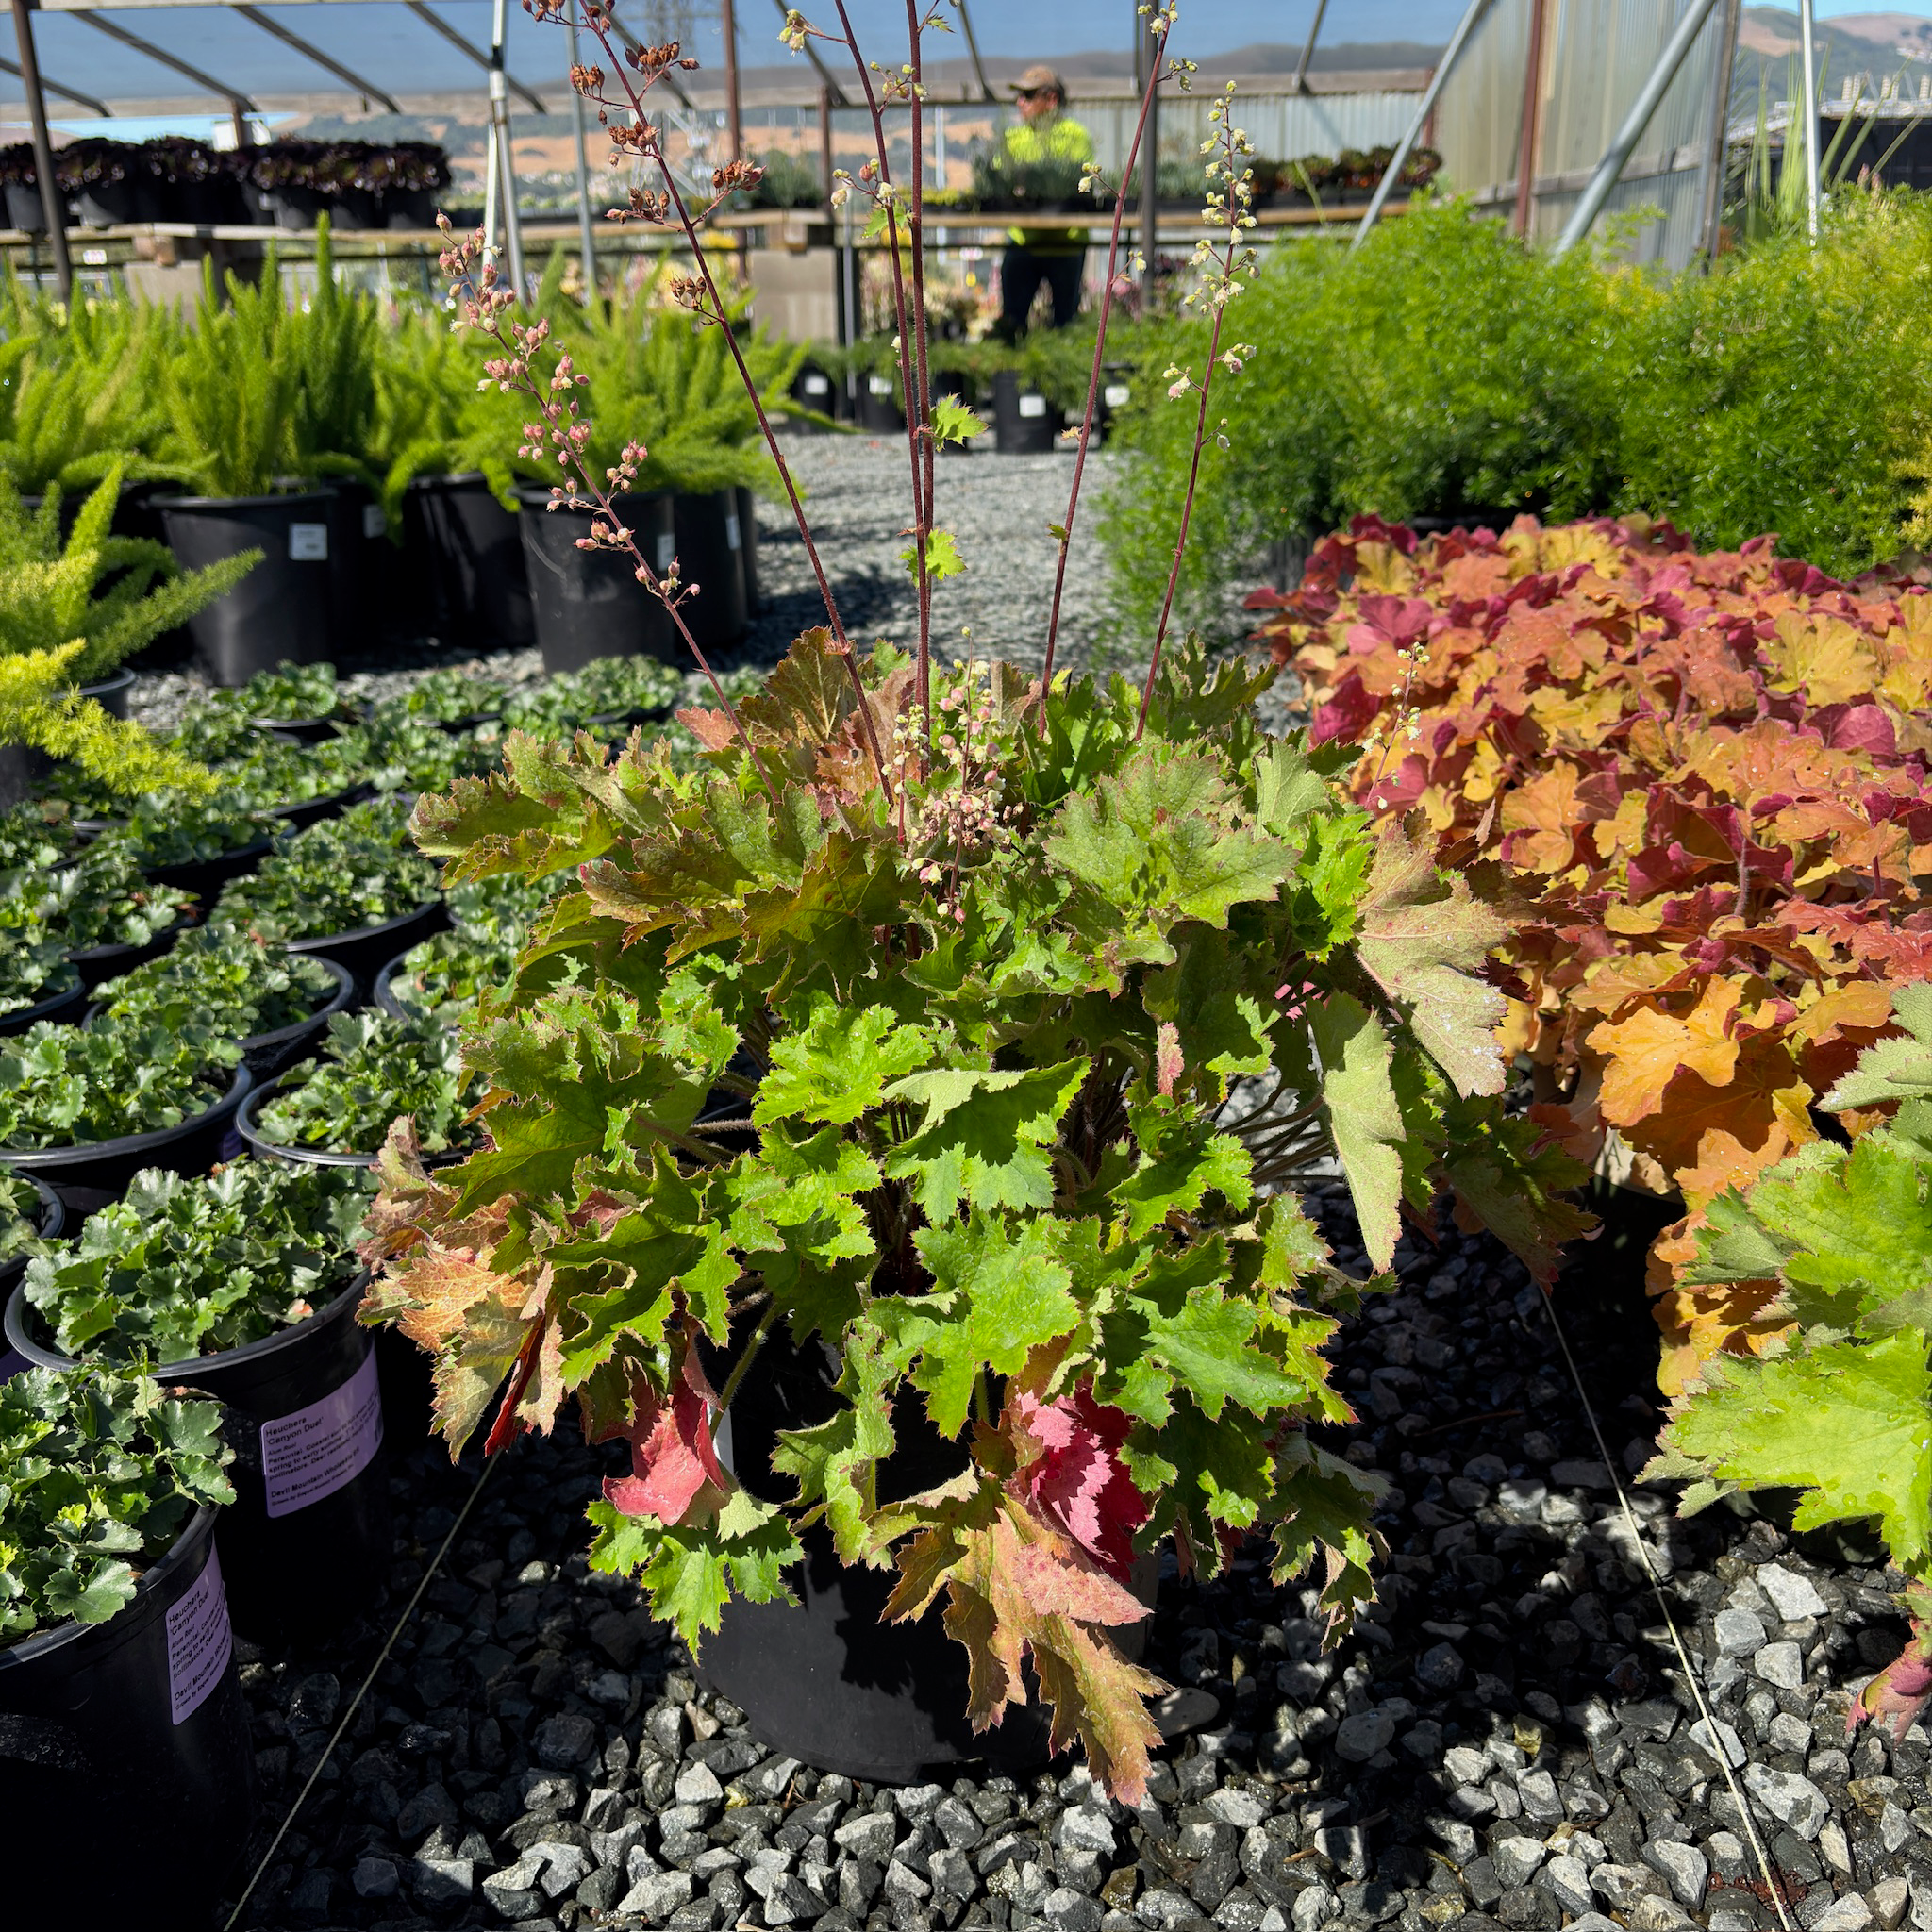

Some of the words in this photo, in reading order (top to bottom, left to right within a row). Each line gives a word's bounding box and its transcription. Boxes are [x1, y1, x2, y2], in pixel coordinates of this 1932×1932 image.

[266, 1417, 307, 1437] Heuchera
[269, 1459, 291, 1474] spring
[293, 1457, 301, 1465] to
[271, 1485, 291, 1498] Devil
[291, 1474, 324, 1491] Mountain
[169, 1591, 200, 1625] Heuchera
[172, 1650, 192, 1671] spring
[175, 1681, 192, 1701] Devil
[192, 1656, 215, 1686] Mountain
